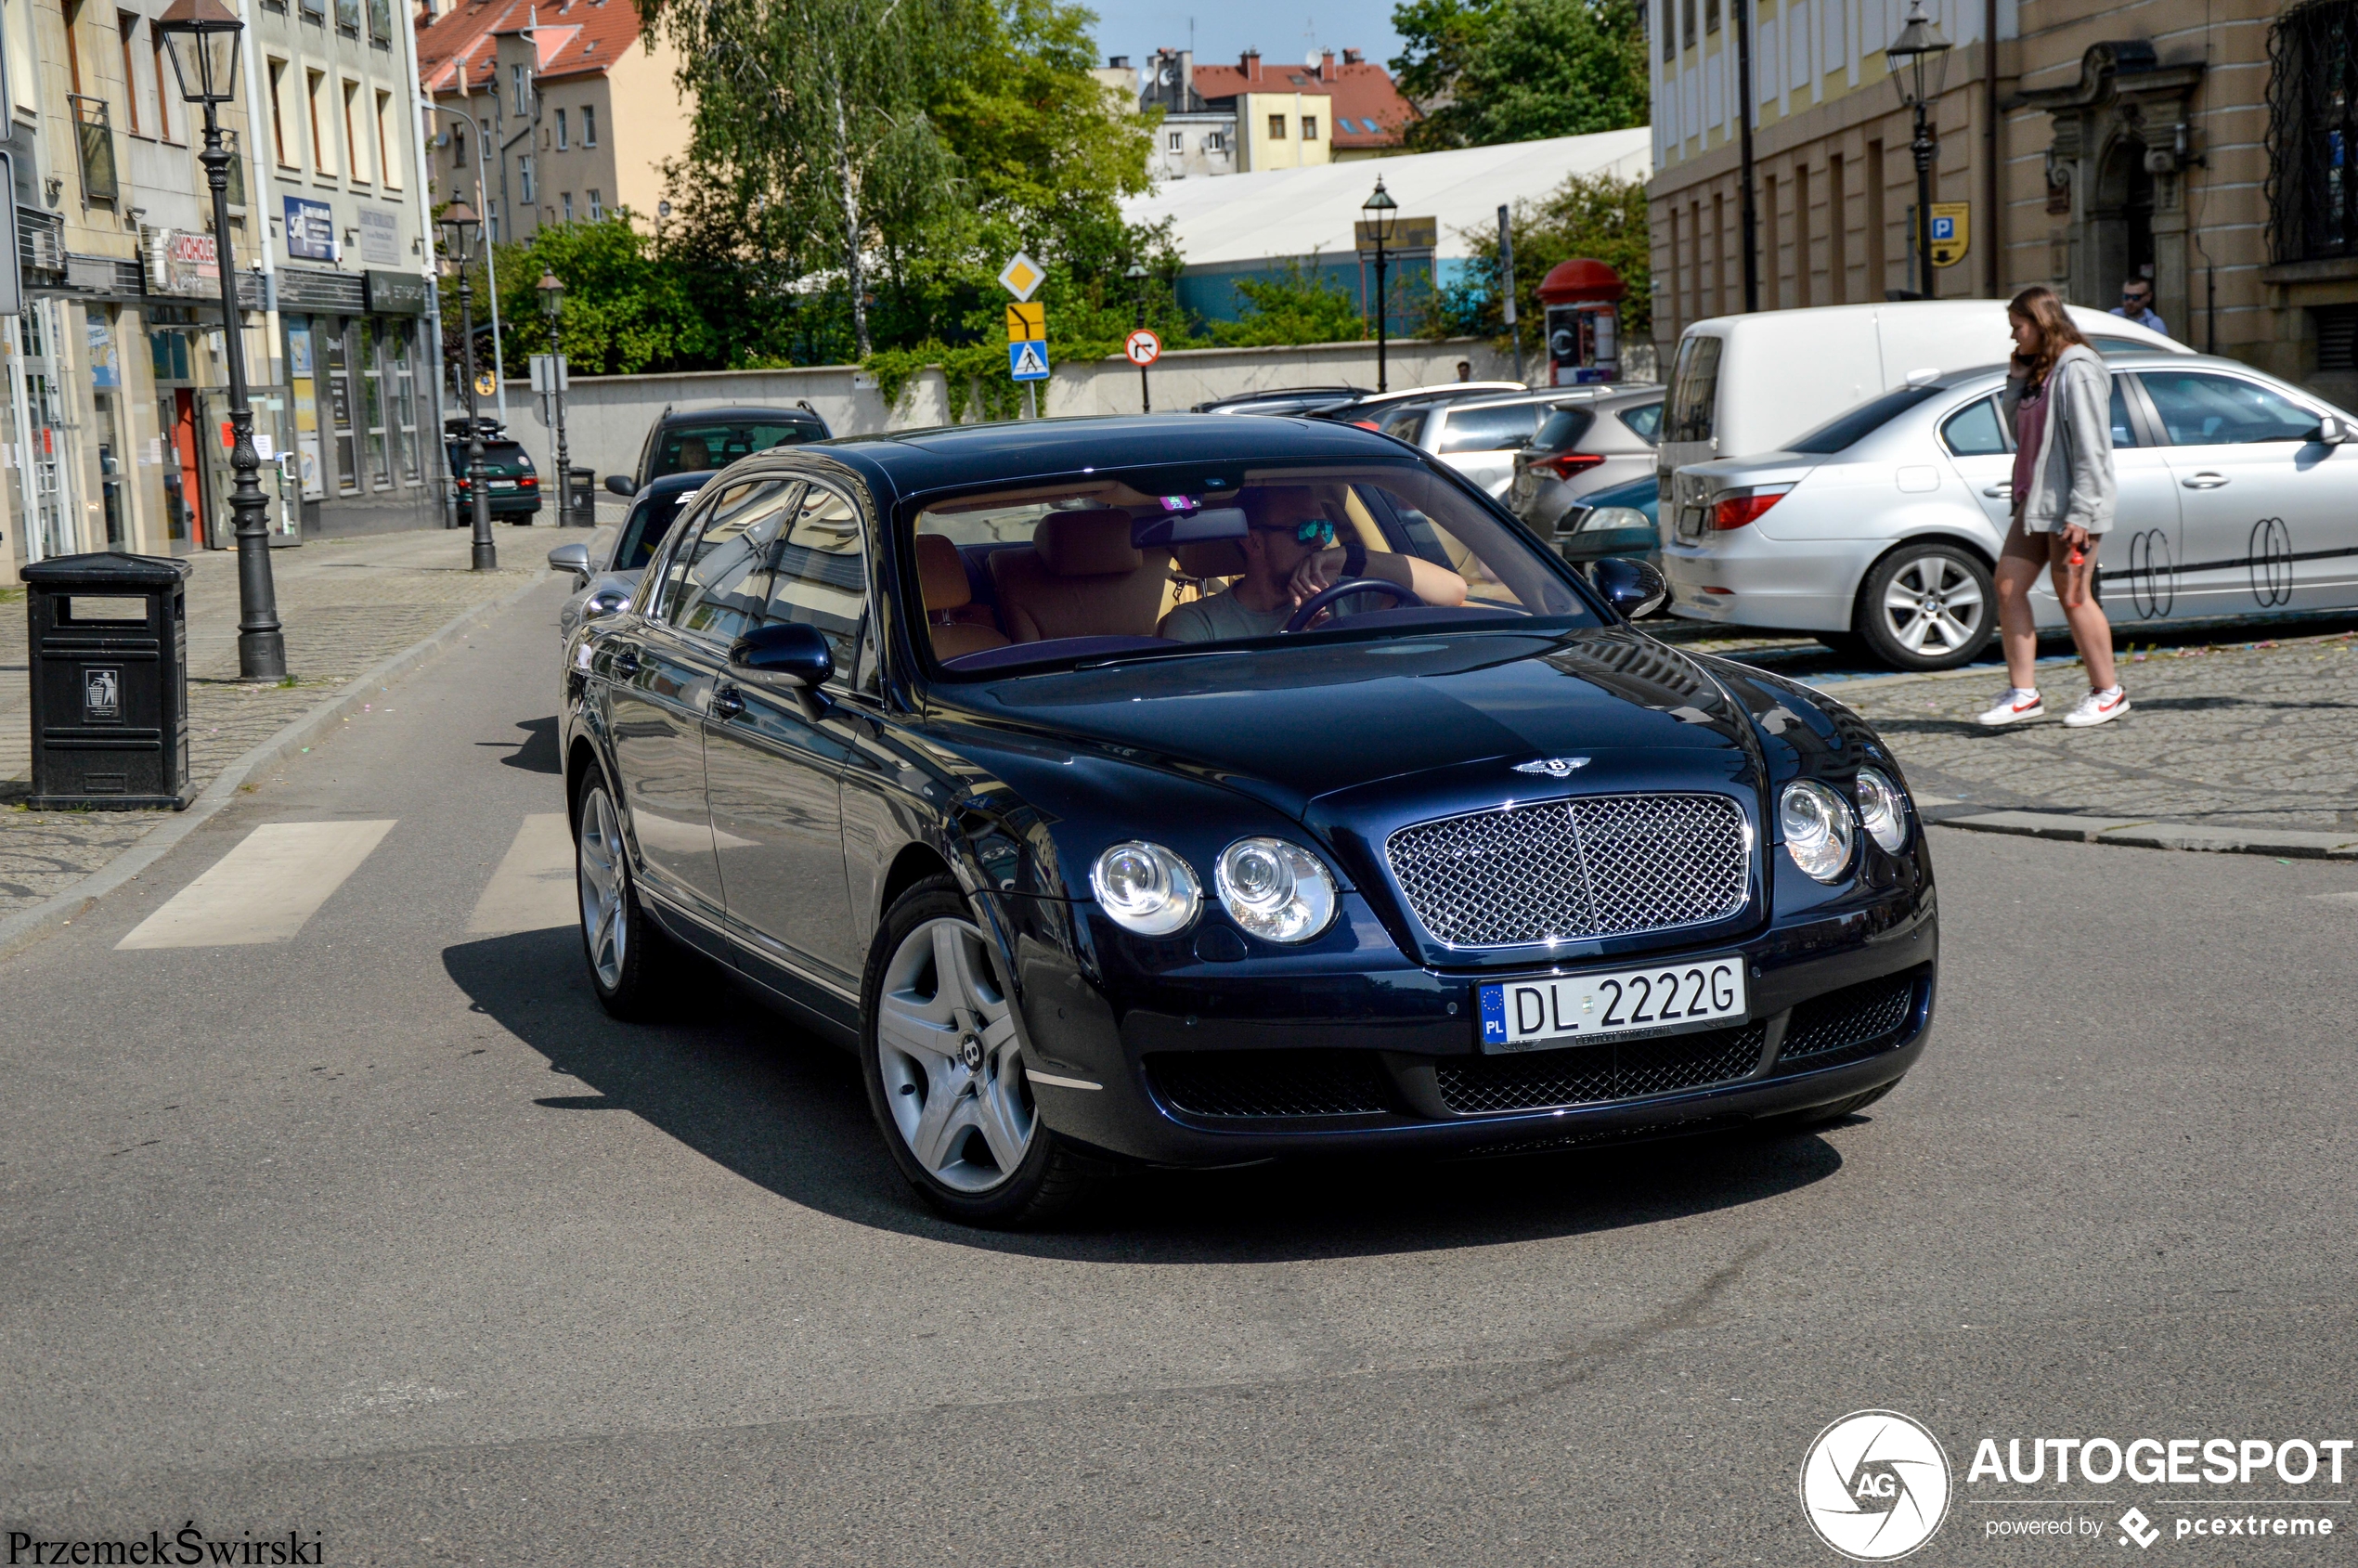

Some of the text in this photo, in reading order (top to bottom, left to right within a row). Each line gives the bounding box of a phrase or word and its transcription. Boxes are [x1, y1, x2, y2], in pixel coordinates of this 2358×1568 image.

[1937, 219, 1950, 237] P
[1515, 965, 1734, 1035] DL 2222G
[1485, 1020, 1504, 1035] PL
[1575, 1026, 1674, 1045] BENTLEY WARSZAWA
